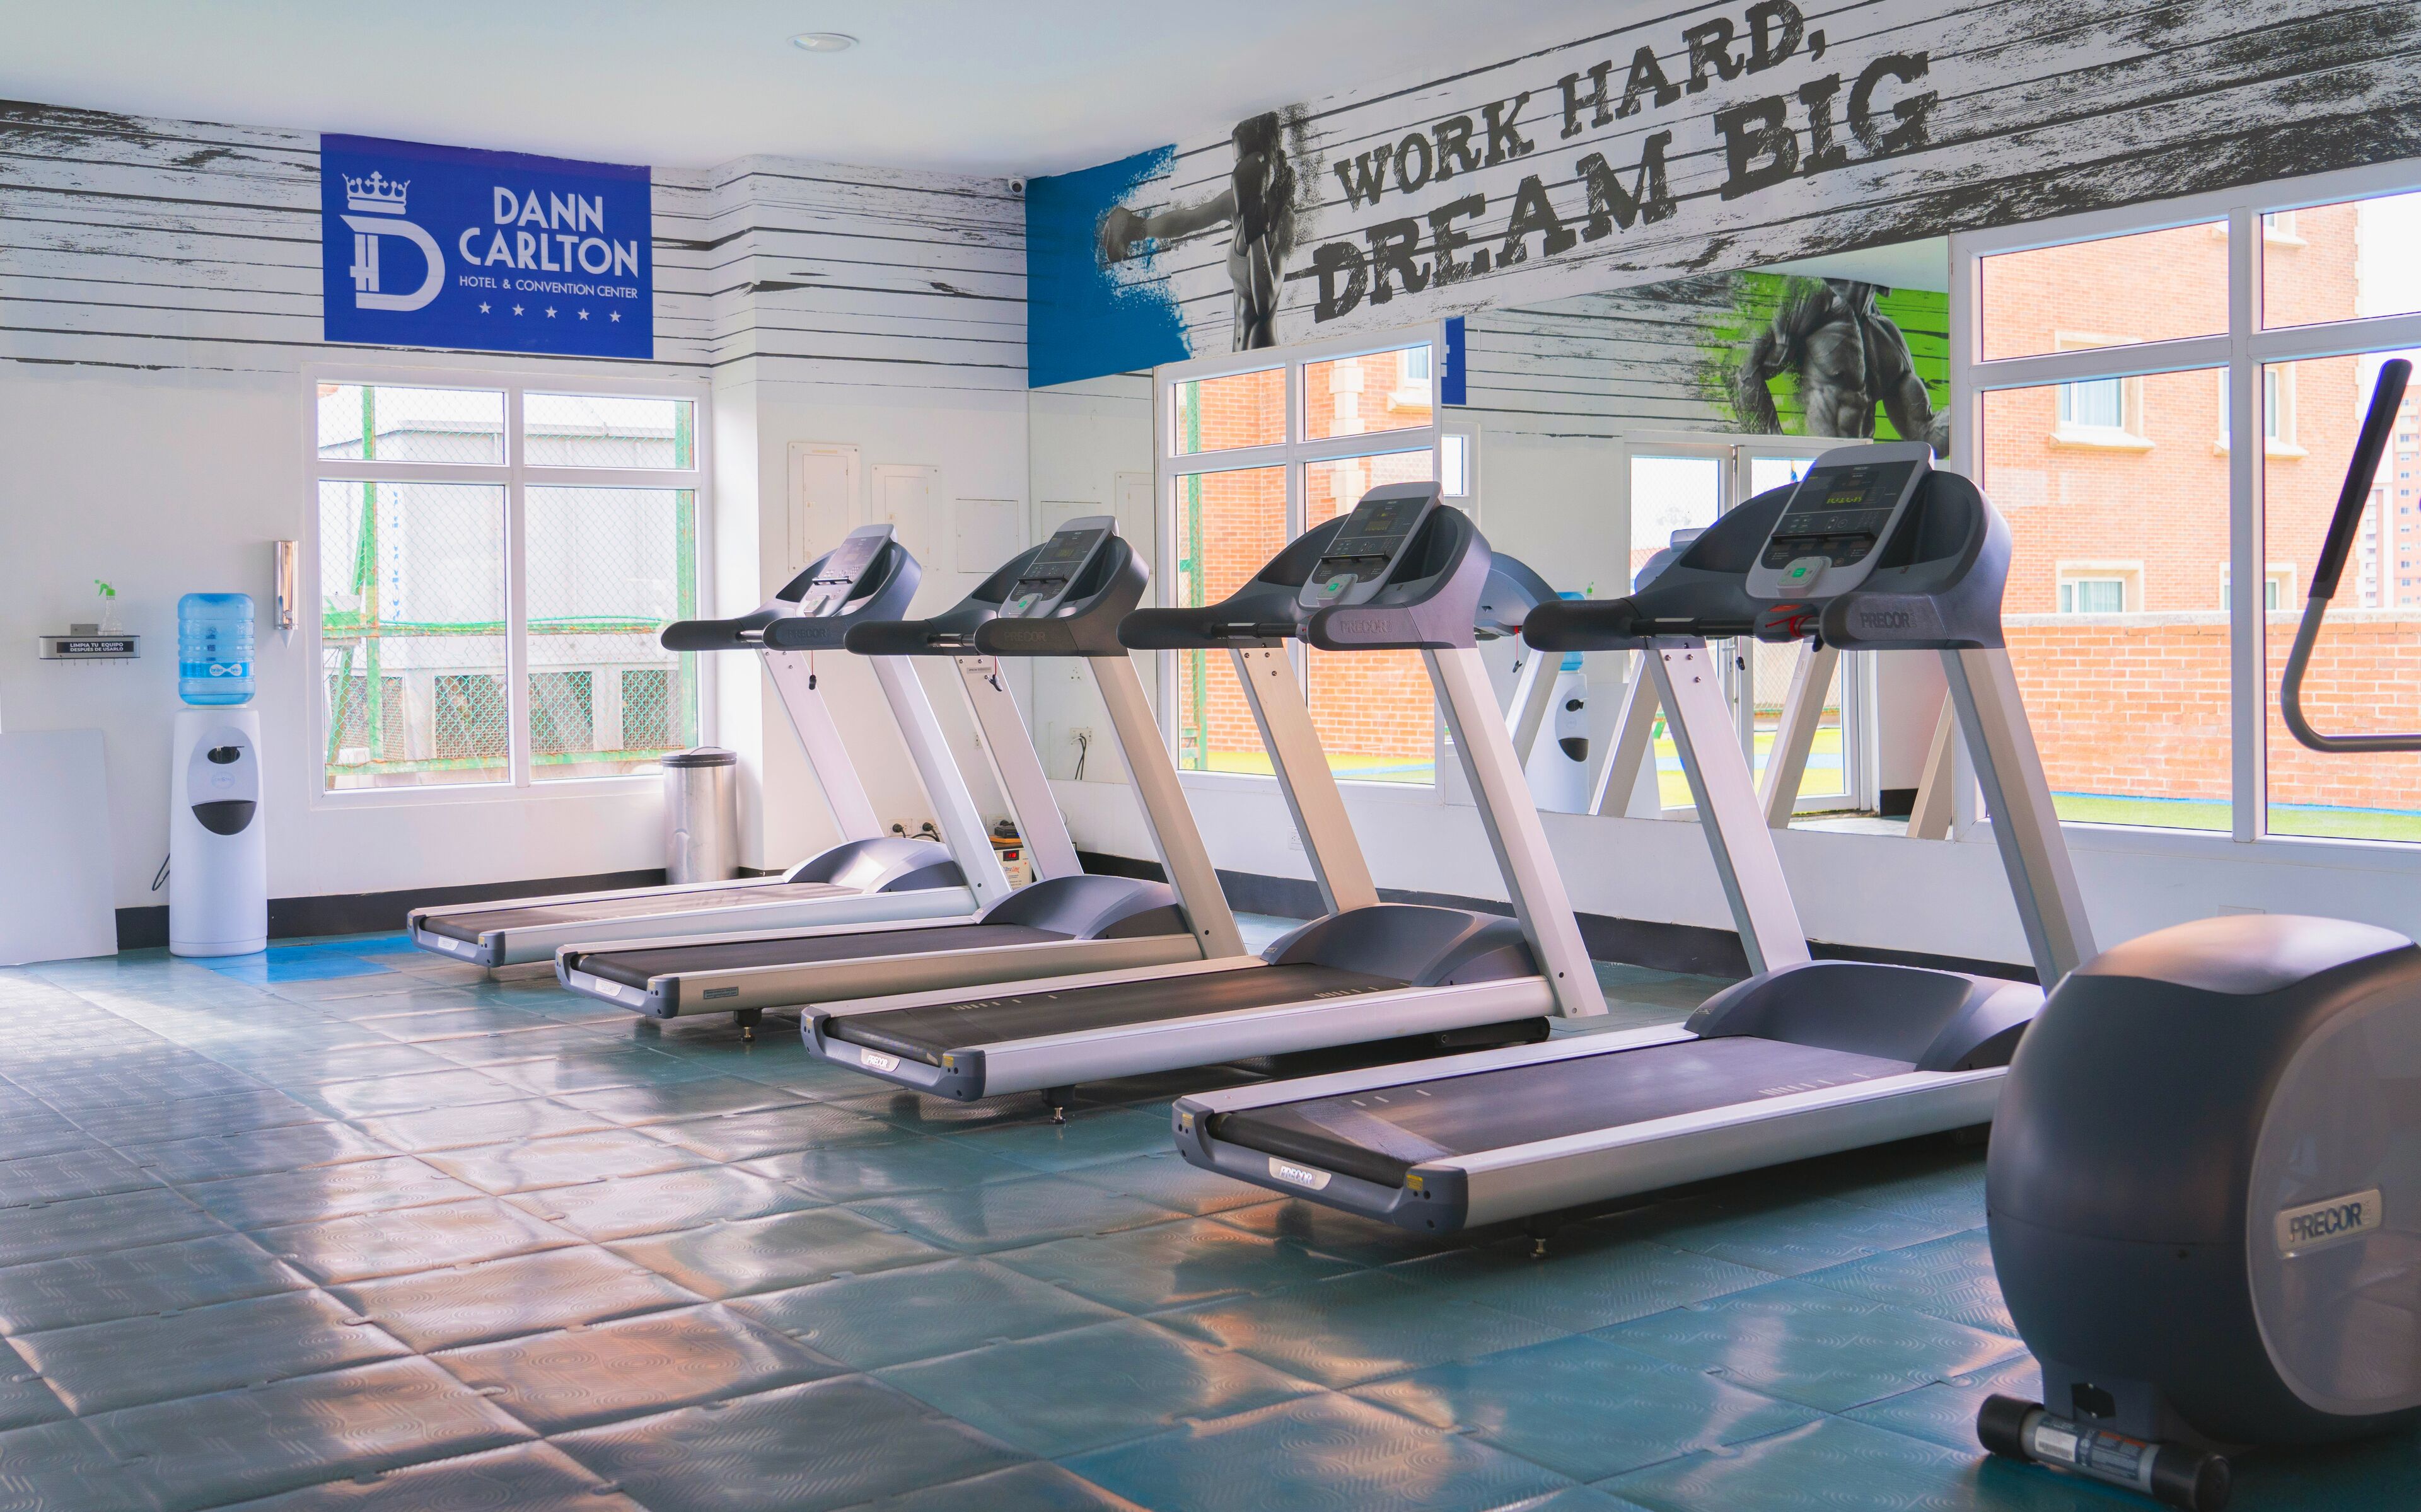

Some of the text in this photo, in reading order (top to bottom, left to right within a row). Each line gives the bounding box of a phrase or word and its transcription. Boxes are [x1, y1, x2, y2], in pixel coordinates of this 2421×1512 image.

[1333, 0, 1825, 213] WORK HARD,
[1313, 50, 1938, 324] DREAM BIG
[494, 187, 603, 234] DANN
[460, 228, 638, 277] CARLTON
[460, 275, 638, 299] HOTEL & CONVENTION CENTER
[1340, 620, 1388, 633] PRECOR
[1860, 610, 1911, 629] PRECOR
[1004, 631, 1047, 642] PRECOR
[868, 1054, 888, 1068] PRECOR
[1280, 1165, 1313, 1185] PRECOR
[2289, 1201, 2362, 1242] PRECOR
